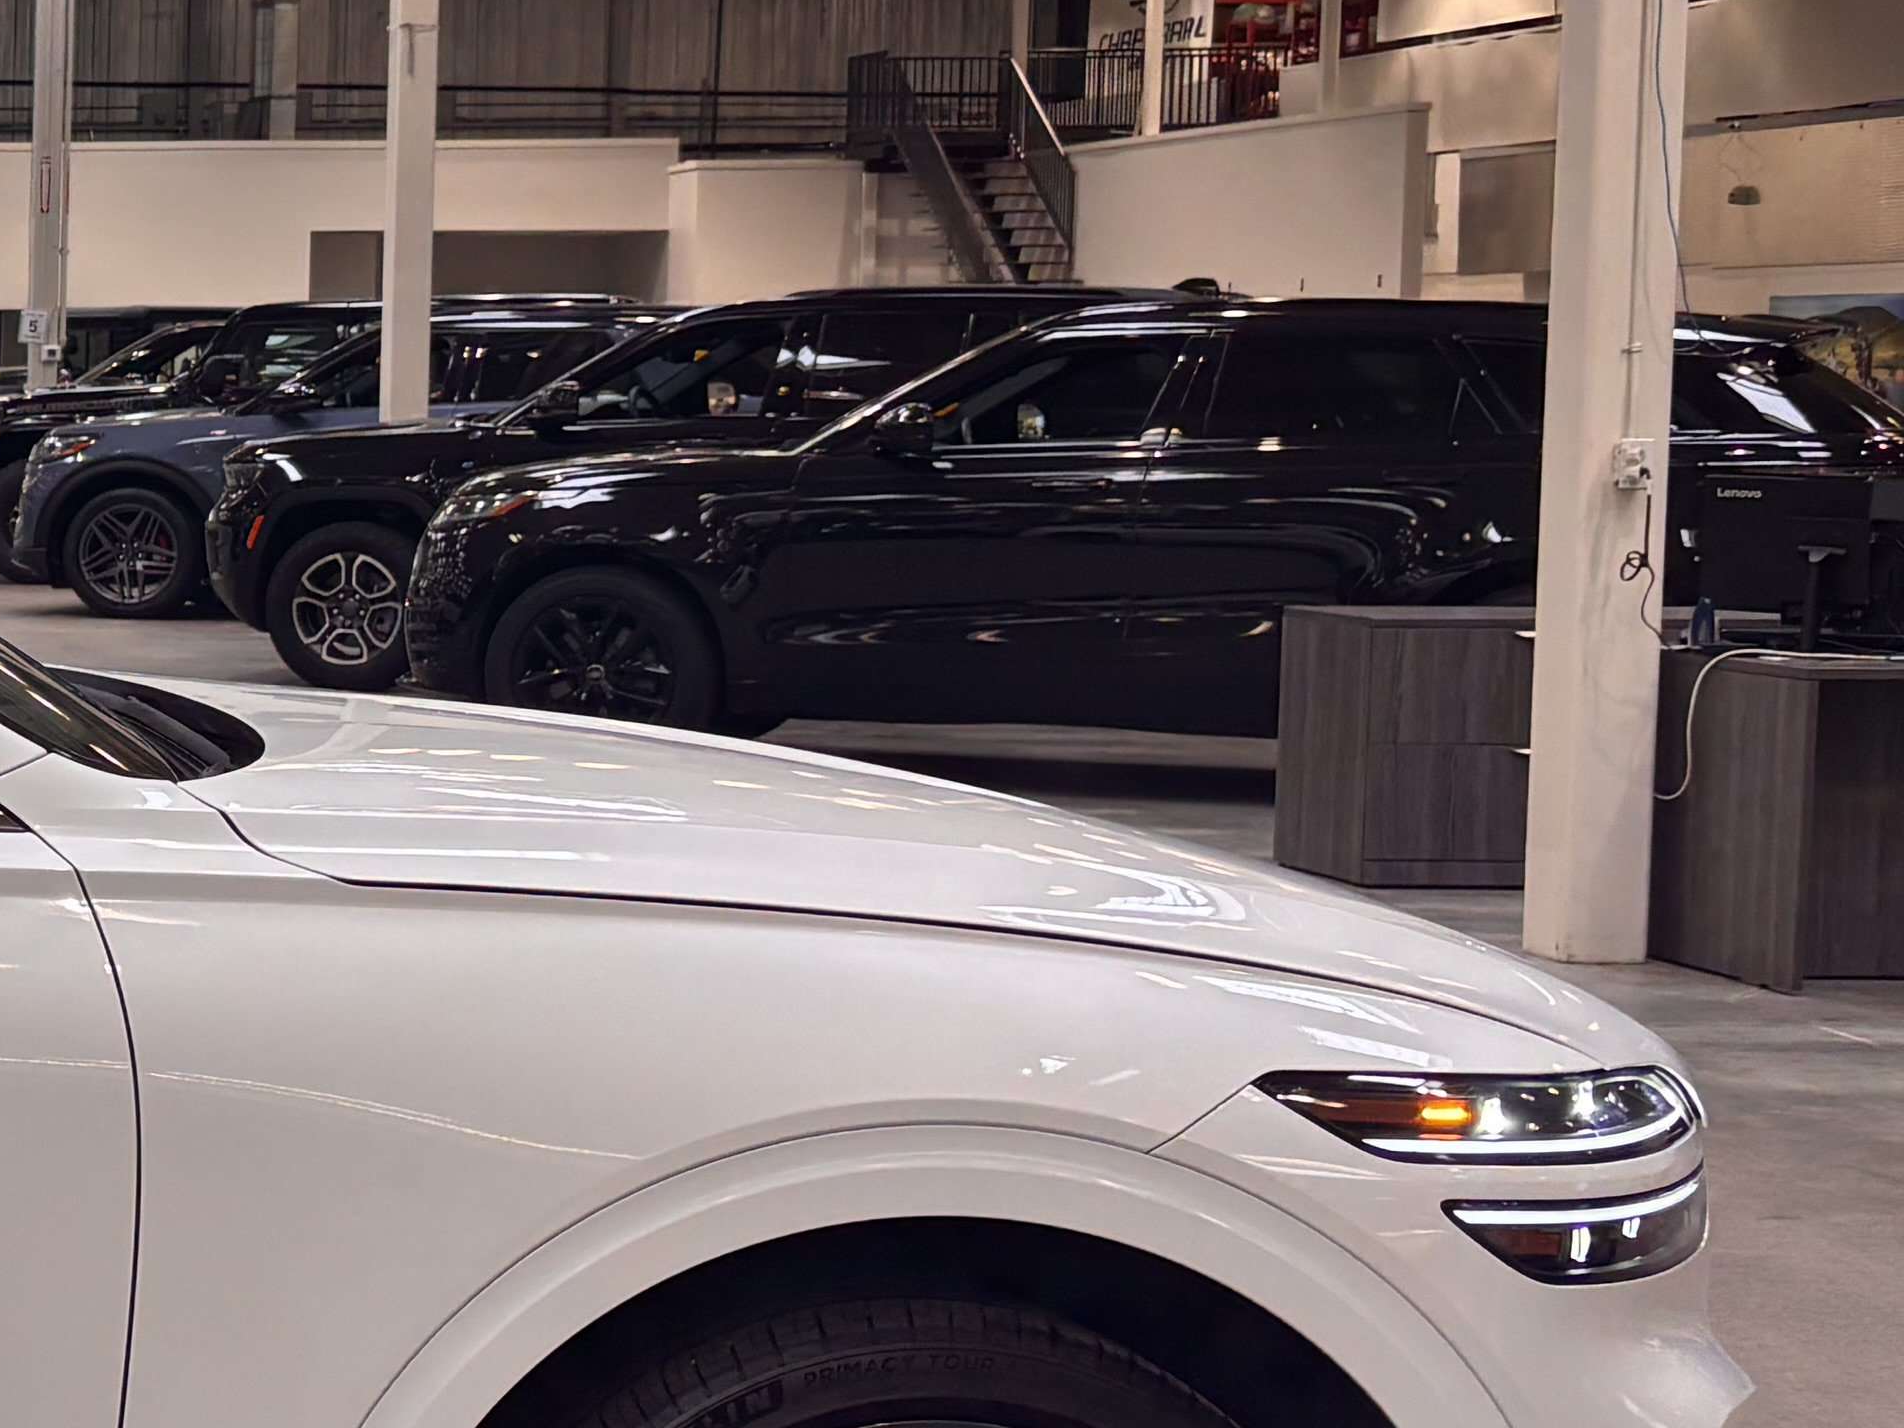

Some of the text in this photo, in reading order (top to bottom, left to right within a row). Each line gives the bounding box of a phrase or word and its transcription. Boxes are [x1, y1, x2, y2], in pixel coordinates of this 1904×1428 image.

[29, 319, 39, 333] 5
[1716, 486, 1762, 499] Lenovo
[929, 1353, 996, 1372] TOUR
